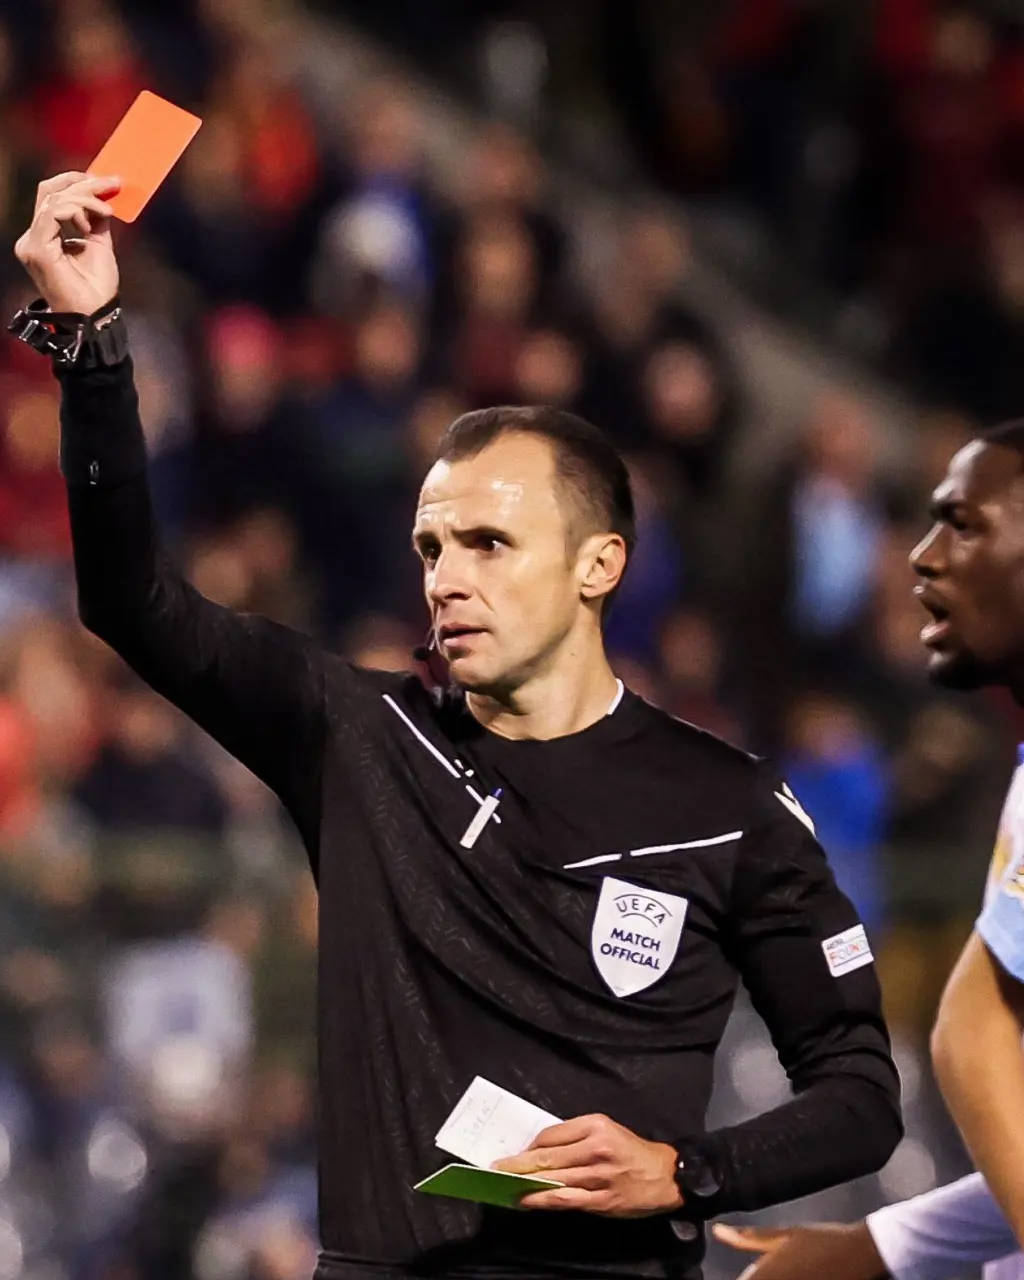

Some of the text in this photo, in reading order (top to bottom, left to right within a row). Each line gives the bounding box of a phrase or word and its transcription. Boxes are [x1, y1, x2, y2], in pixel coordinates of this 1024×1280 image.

[616, 898, 666, 924] UEFA
[610, 927, 661, 951] MATCH
[600, 942, 660, 970] OFFICIAL
